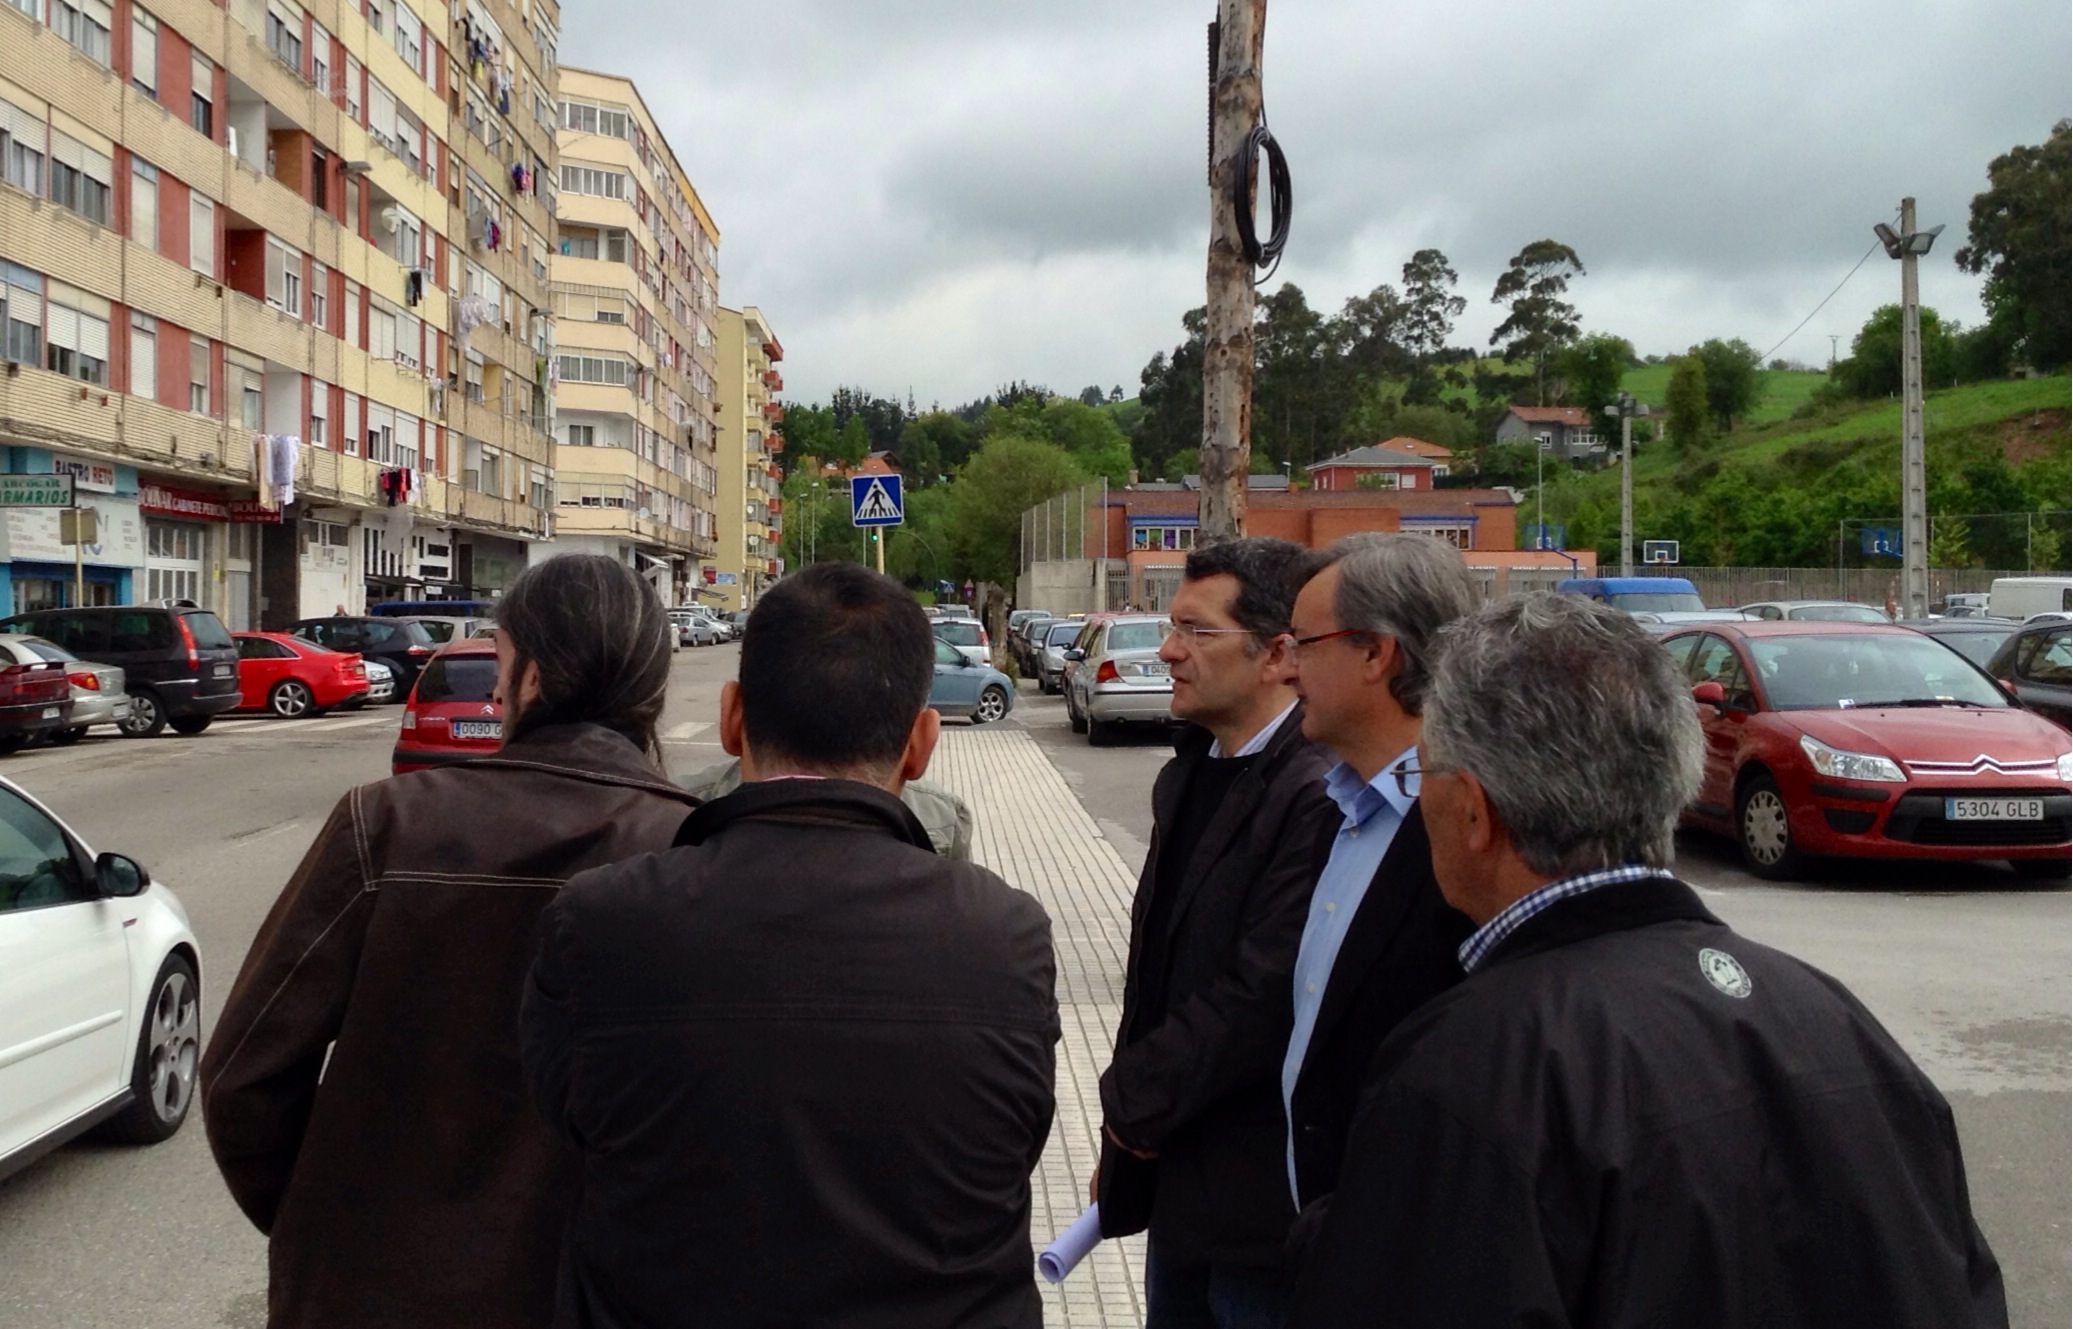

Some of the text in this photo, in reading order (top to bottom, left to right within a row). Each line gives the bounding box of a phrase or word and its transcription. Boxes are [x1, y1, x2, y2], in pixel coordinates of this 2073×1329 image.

[92, 466, 113, 486] RETO
[462, 723, 491, 735] 0090
[1957, 801, 2040, 818] 5304 GLB
